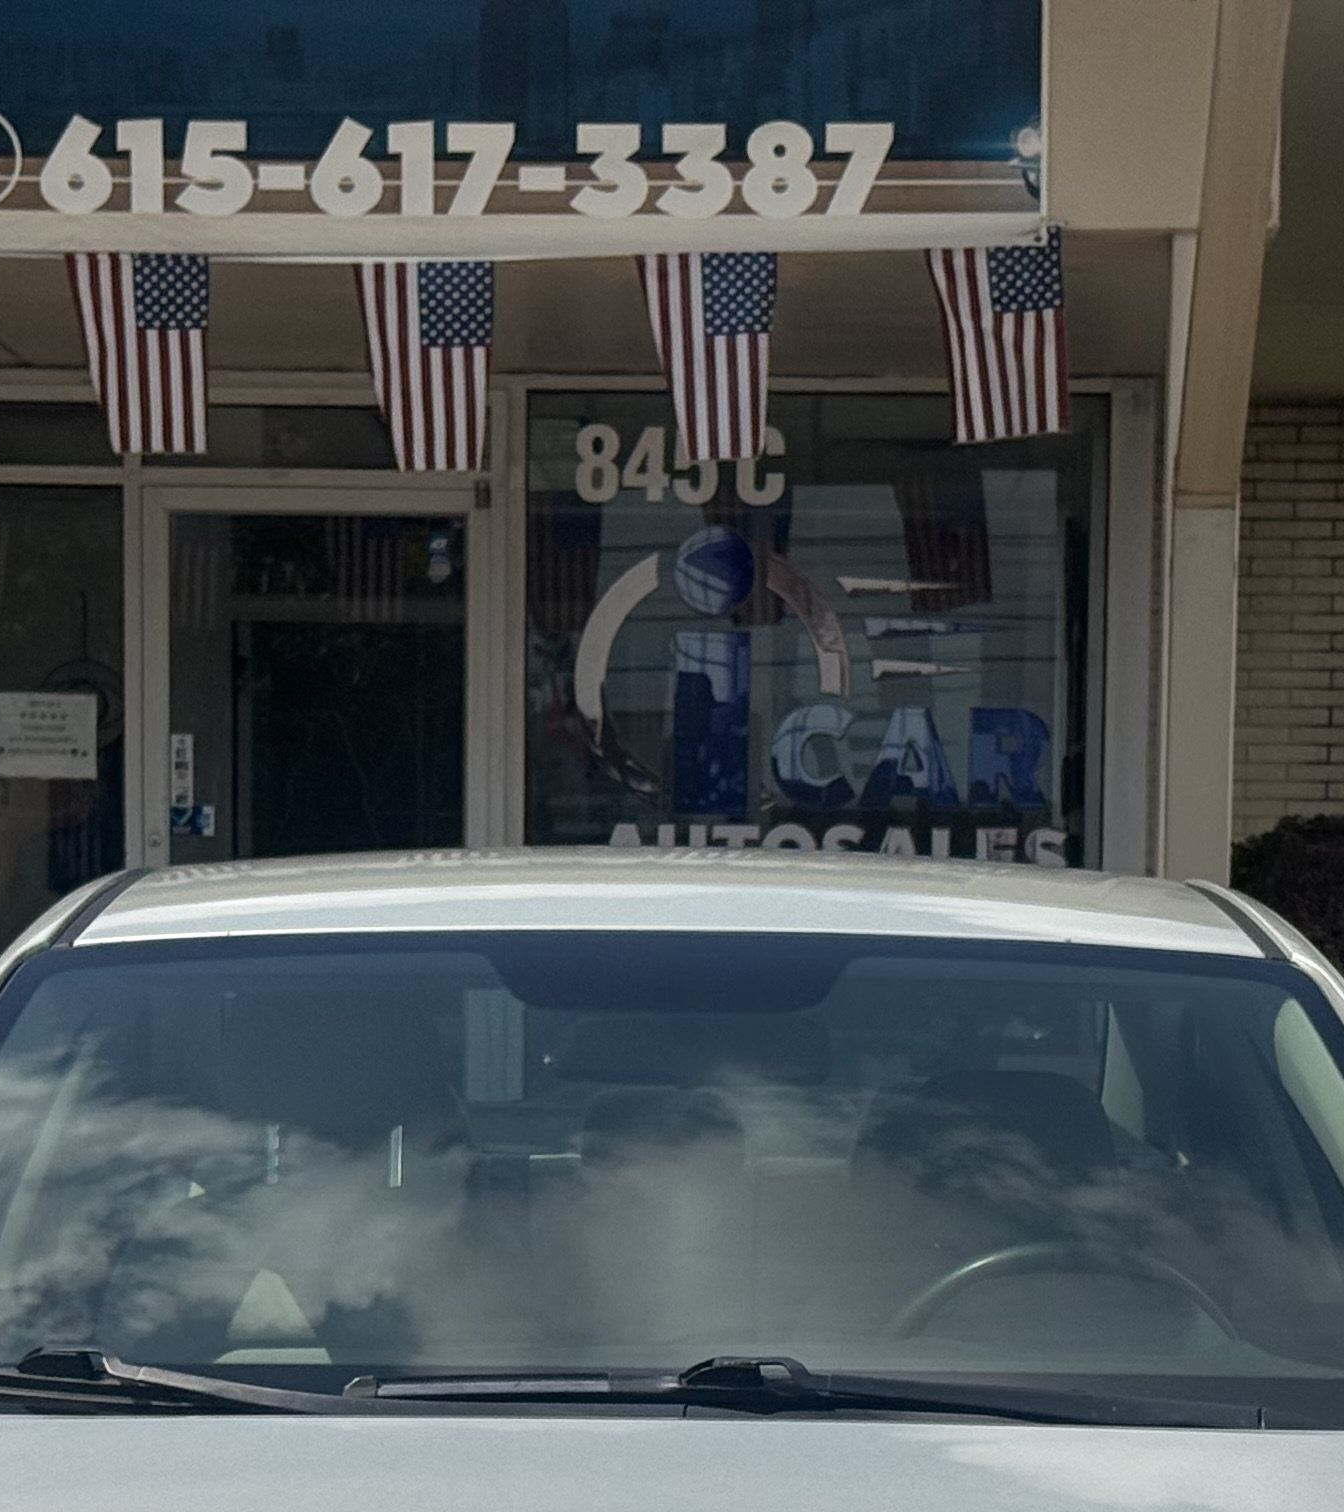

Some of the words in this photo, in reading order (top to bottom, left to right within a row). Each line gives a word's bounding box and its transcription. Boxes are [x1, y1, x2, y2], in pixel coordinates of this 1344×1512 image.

[40, 112, 897, 219] 615-617-3387
[575, 423, 719, 506] 845
[770, 703, 1056, 812] CAR
